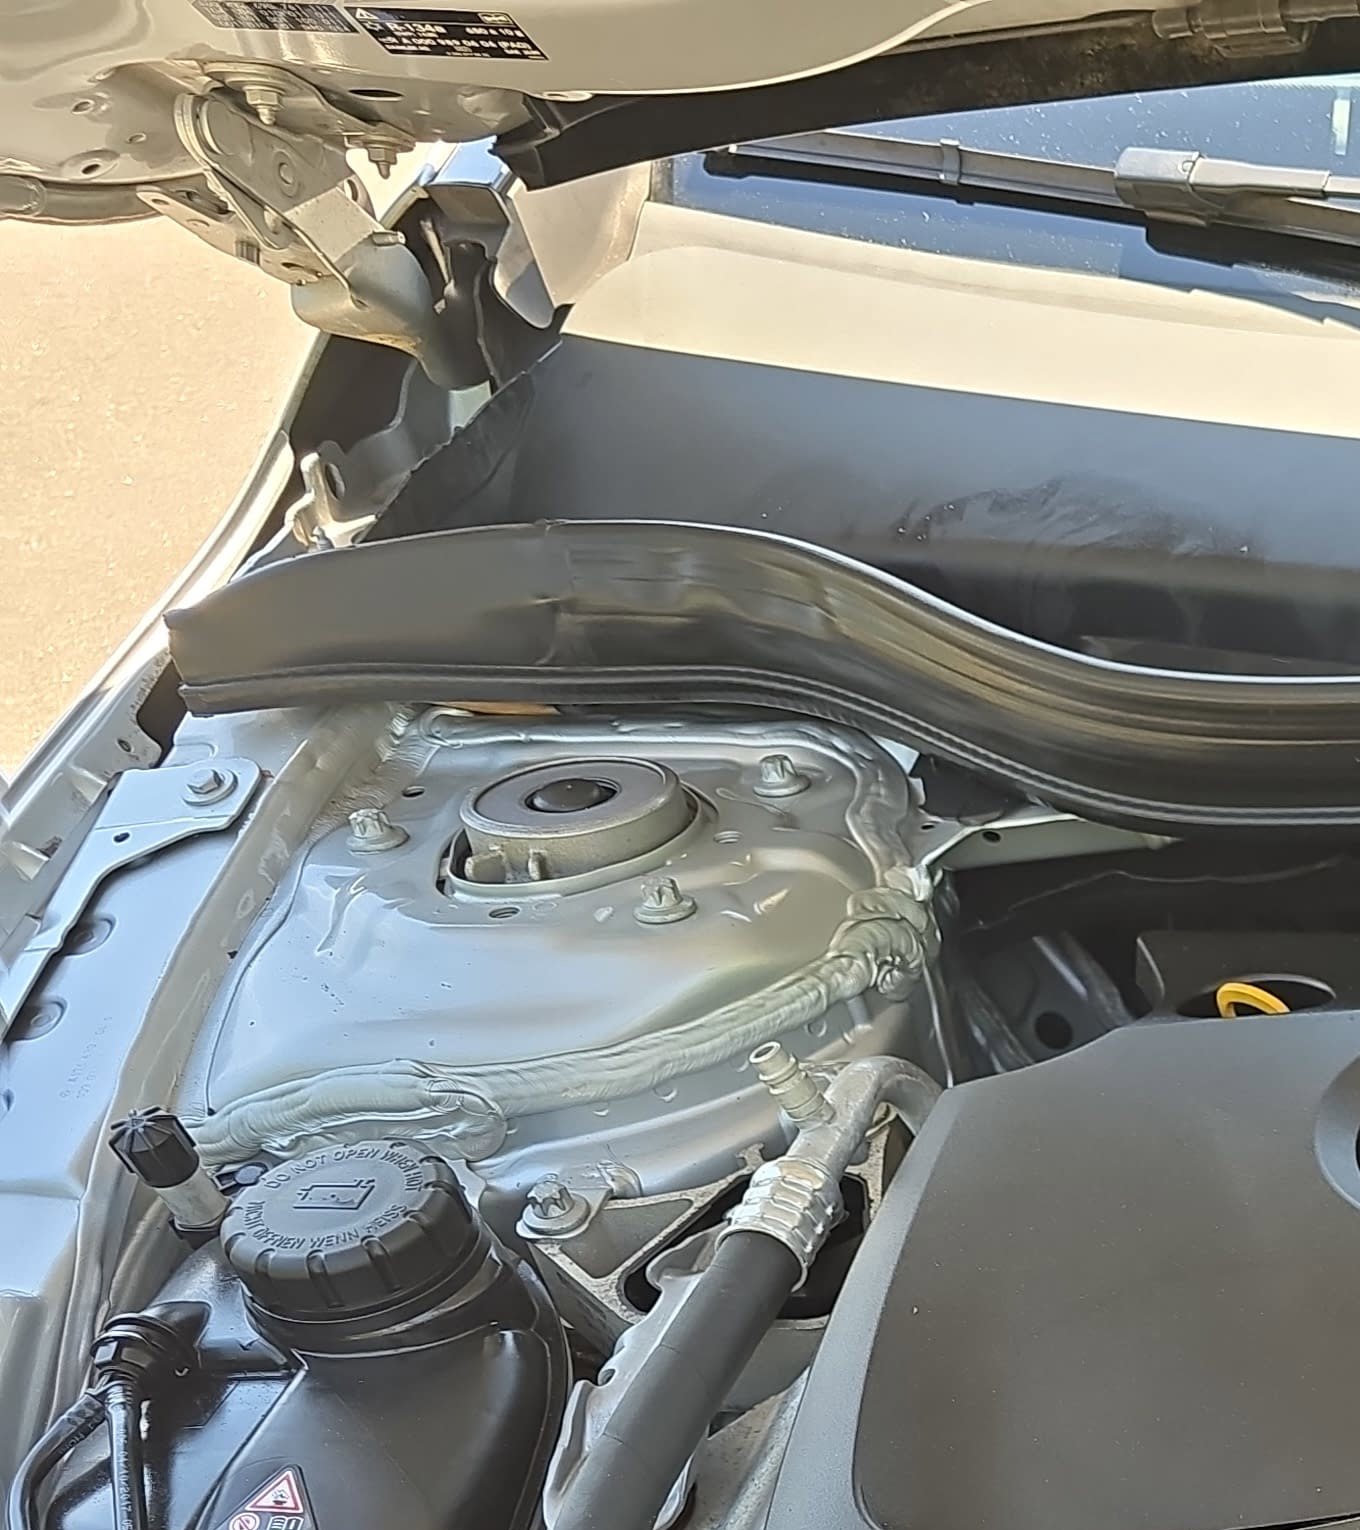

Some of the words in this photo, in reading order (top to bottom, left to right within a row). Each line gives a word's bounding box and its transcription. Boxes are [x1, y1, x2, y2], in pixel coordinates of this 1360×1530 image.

[264, 1173, 291, 1189] DO
[291, 1154, 327, 1174] NOT
[333, 1148, 380, 1161] OPEN
[380, 1149, 420, 1173] WHEN
[404, 1170, 424, 1192] HOT
[309, 1229, 360, 1249] WENN
